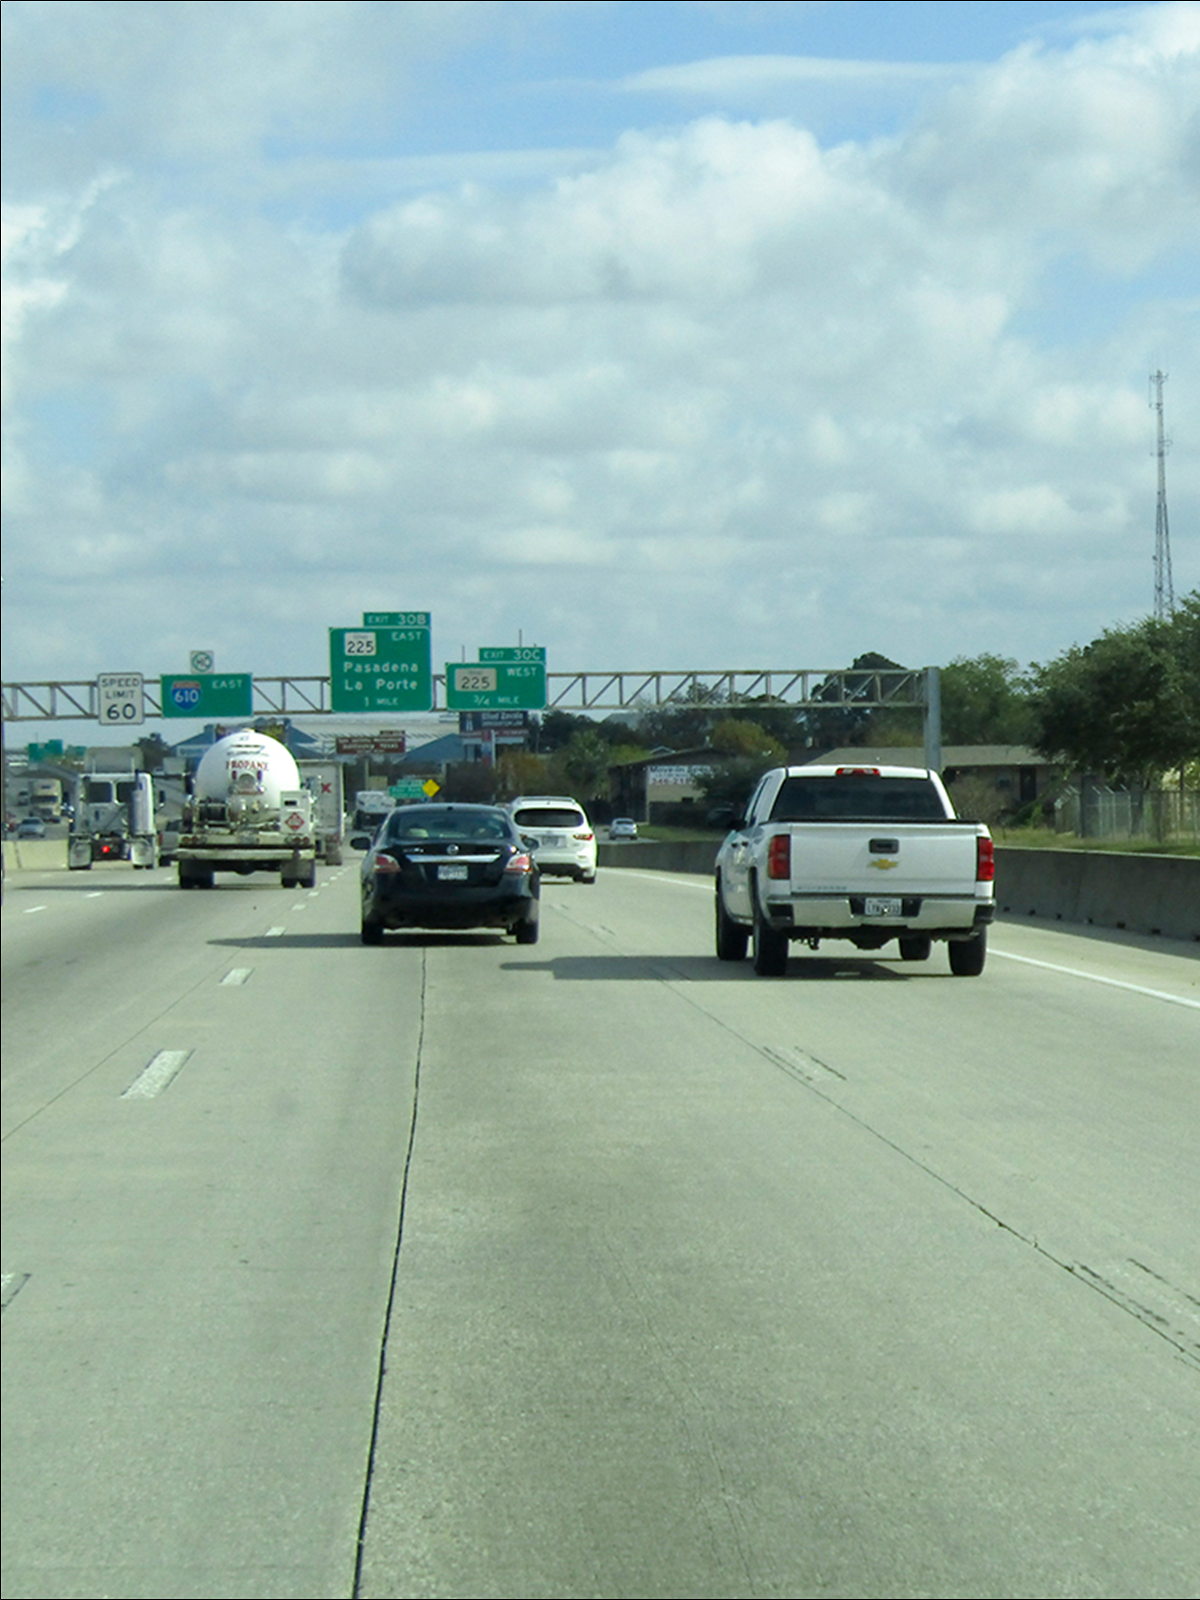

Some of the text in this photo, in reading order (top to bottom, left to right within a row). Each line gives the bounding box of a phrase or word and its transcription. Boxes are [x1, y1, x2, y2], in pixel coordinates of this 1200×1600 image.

[369, 614, 427, 625] EXIT 30B
[392, 631, 422, 641] EAST
[347, 640, 375, 654] 225
[484, 649, 541, 660] EXIT 30C
[344, 661, 418, 673] Pasadena
[507, 667, 537, 677] WEST
[102, 678, 140, 688] SPEED
[212, 679, 243, 690] EAST
[345, 678, 418, 691] La Porte
[461, 676, 490, 690] 225
[105, 690, 135, 700] LIMIT
[174, 690, 199, 703] 610
[498, 696, 519, 705] MILE
[376, 697, 399, 706] MILE
[107, 703, 136, 720] 60
[226, 760, 269, 771] PROPANE
